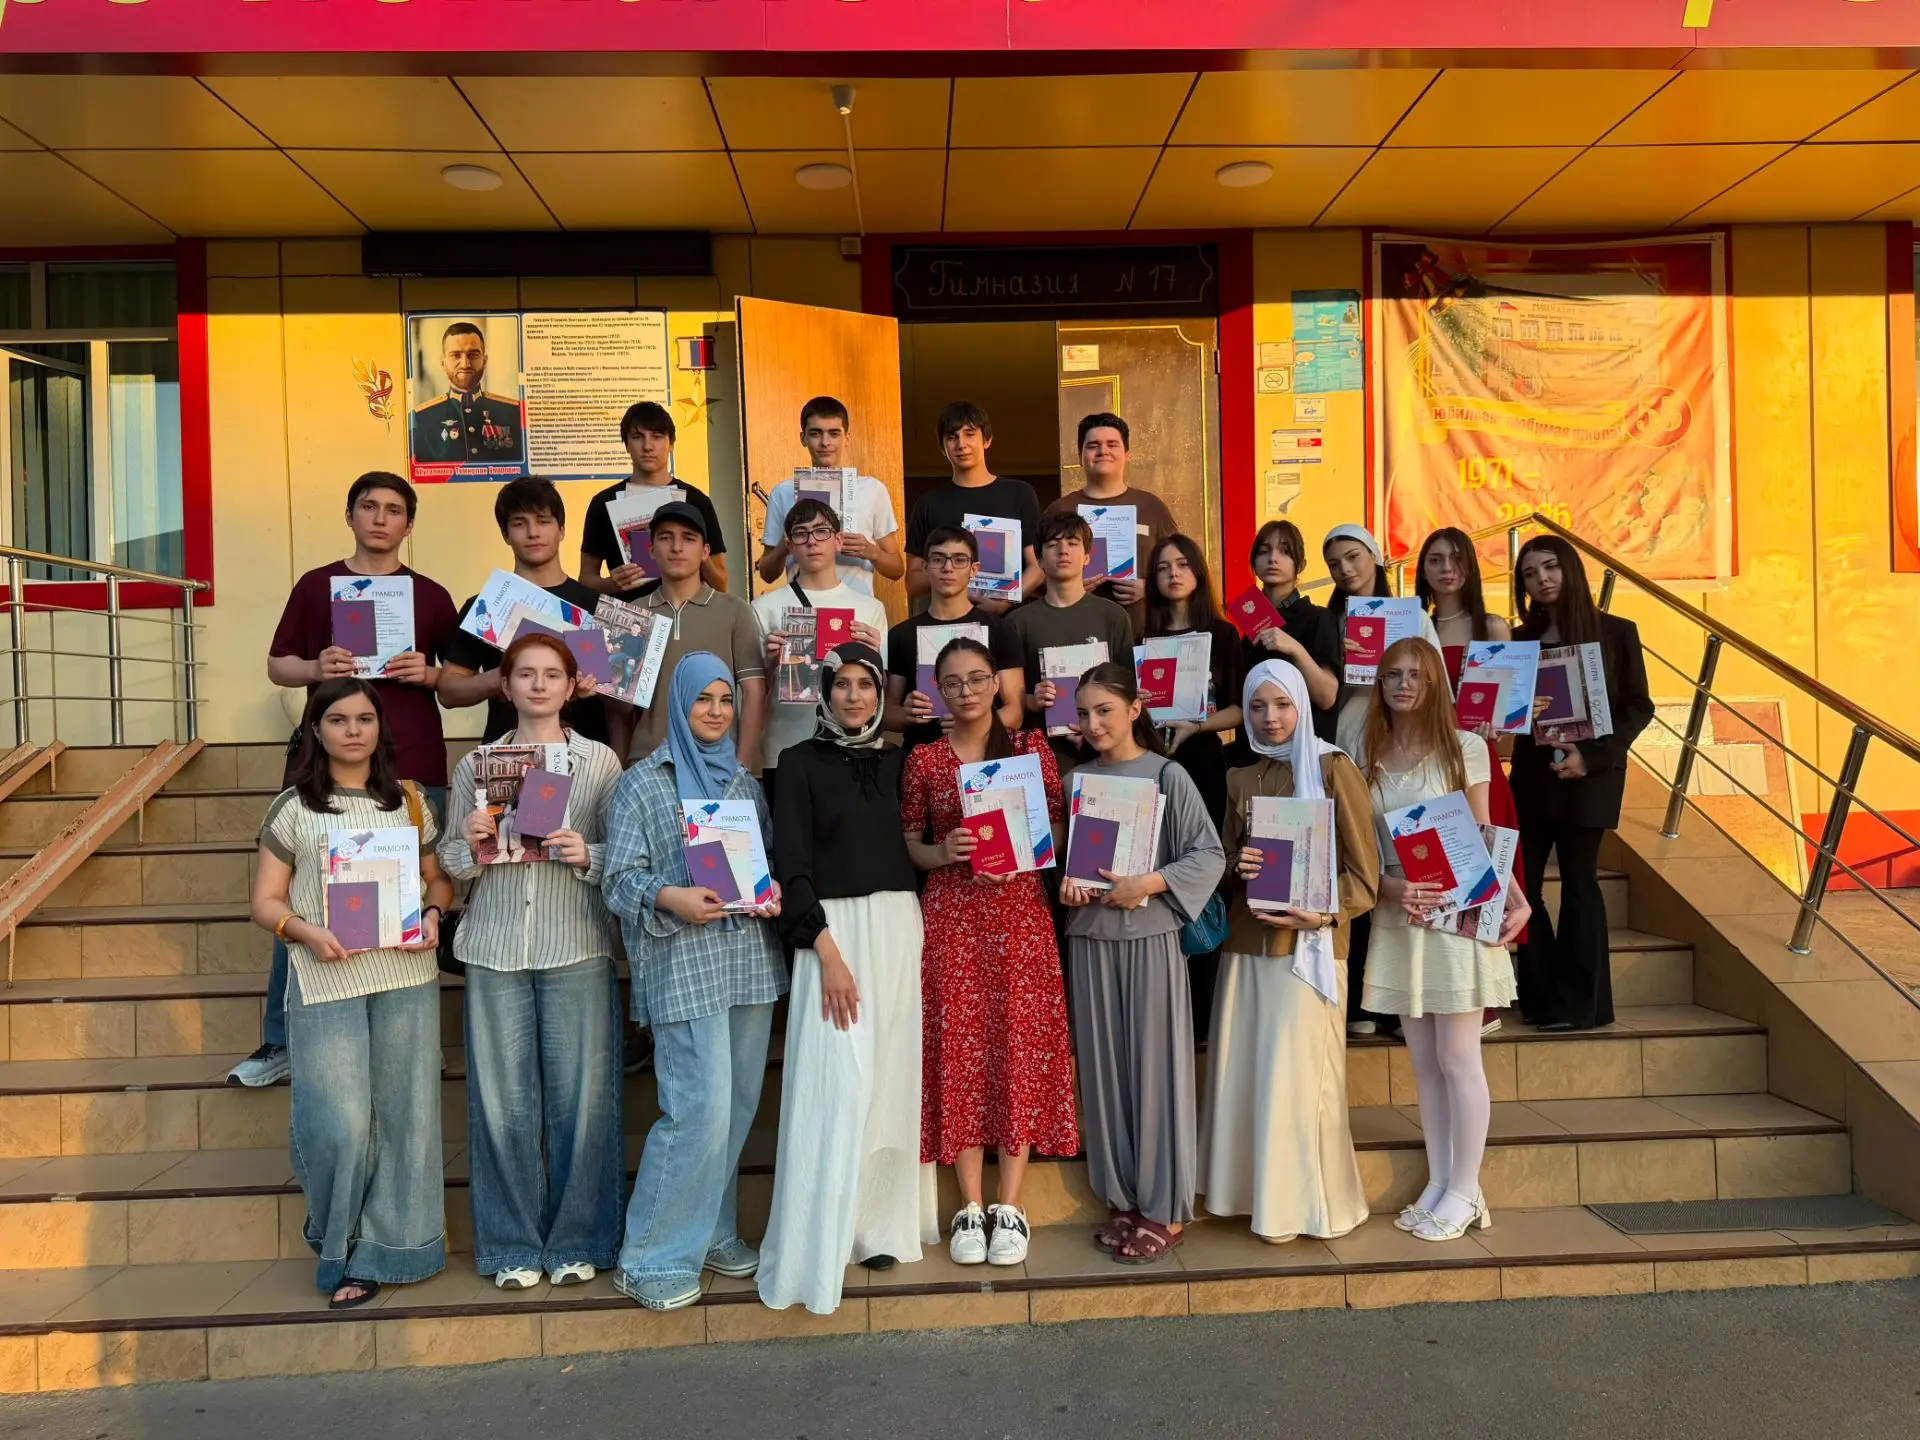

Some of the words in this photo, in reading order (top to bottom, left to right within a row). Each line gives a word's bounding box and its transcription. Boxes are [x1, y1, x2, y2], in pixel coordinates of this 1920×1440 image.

[928, 260, 1079, 296] Гимназия
[1148, 264, 1177, 293] 17
[1457, 457, 1513, 490] 1971
[371, 590, 404, 599] ГРАМОТА
[553, 751, 561, 773] УСК
[1001, 771, 1035, 783] ГРАМОТА
[720, 815, 752, 823] ГРАМОТА
[1429, 808, 1464, 823] ГРАМОТА
[373, 844, 411, 853] ГРАМОТА
[1497, 836, 1511, 875] ВЫПУСК
